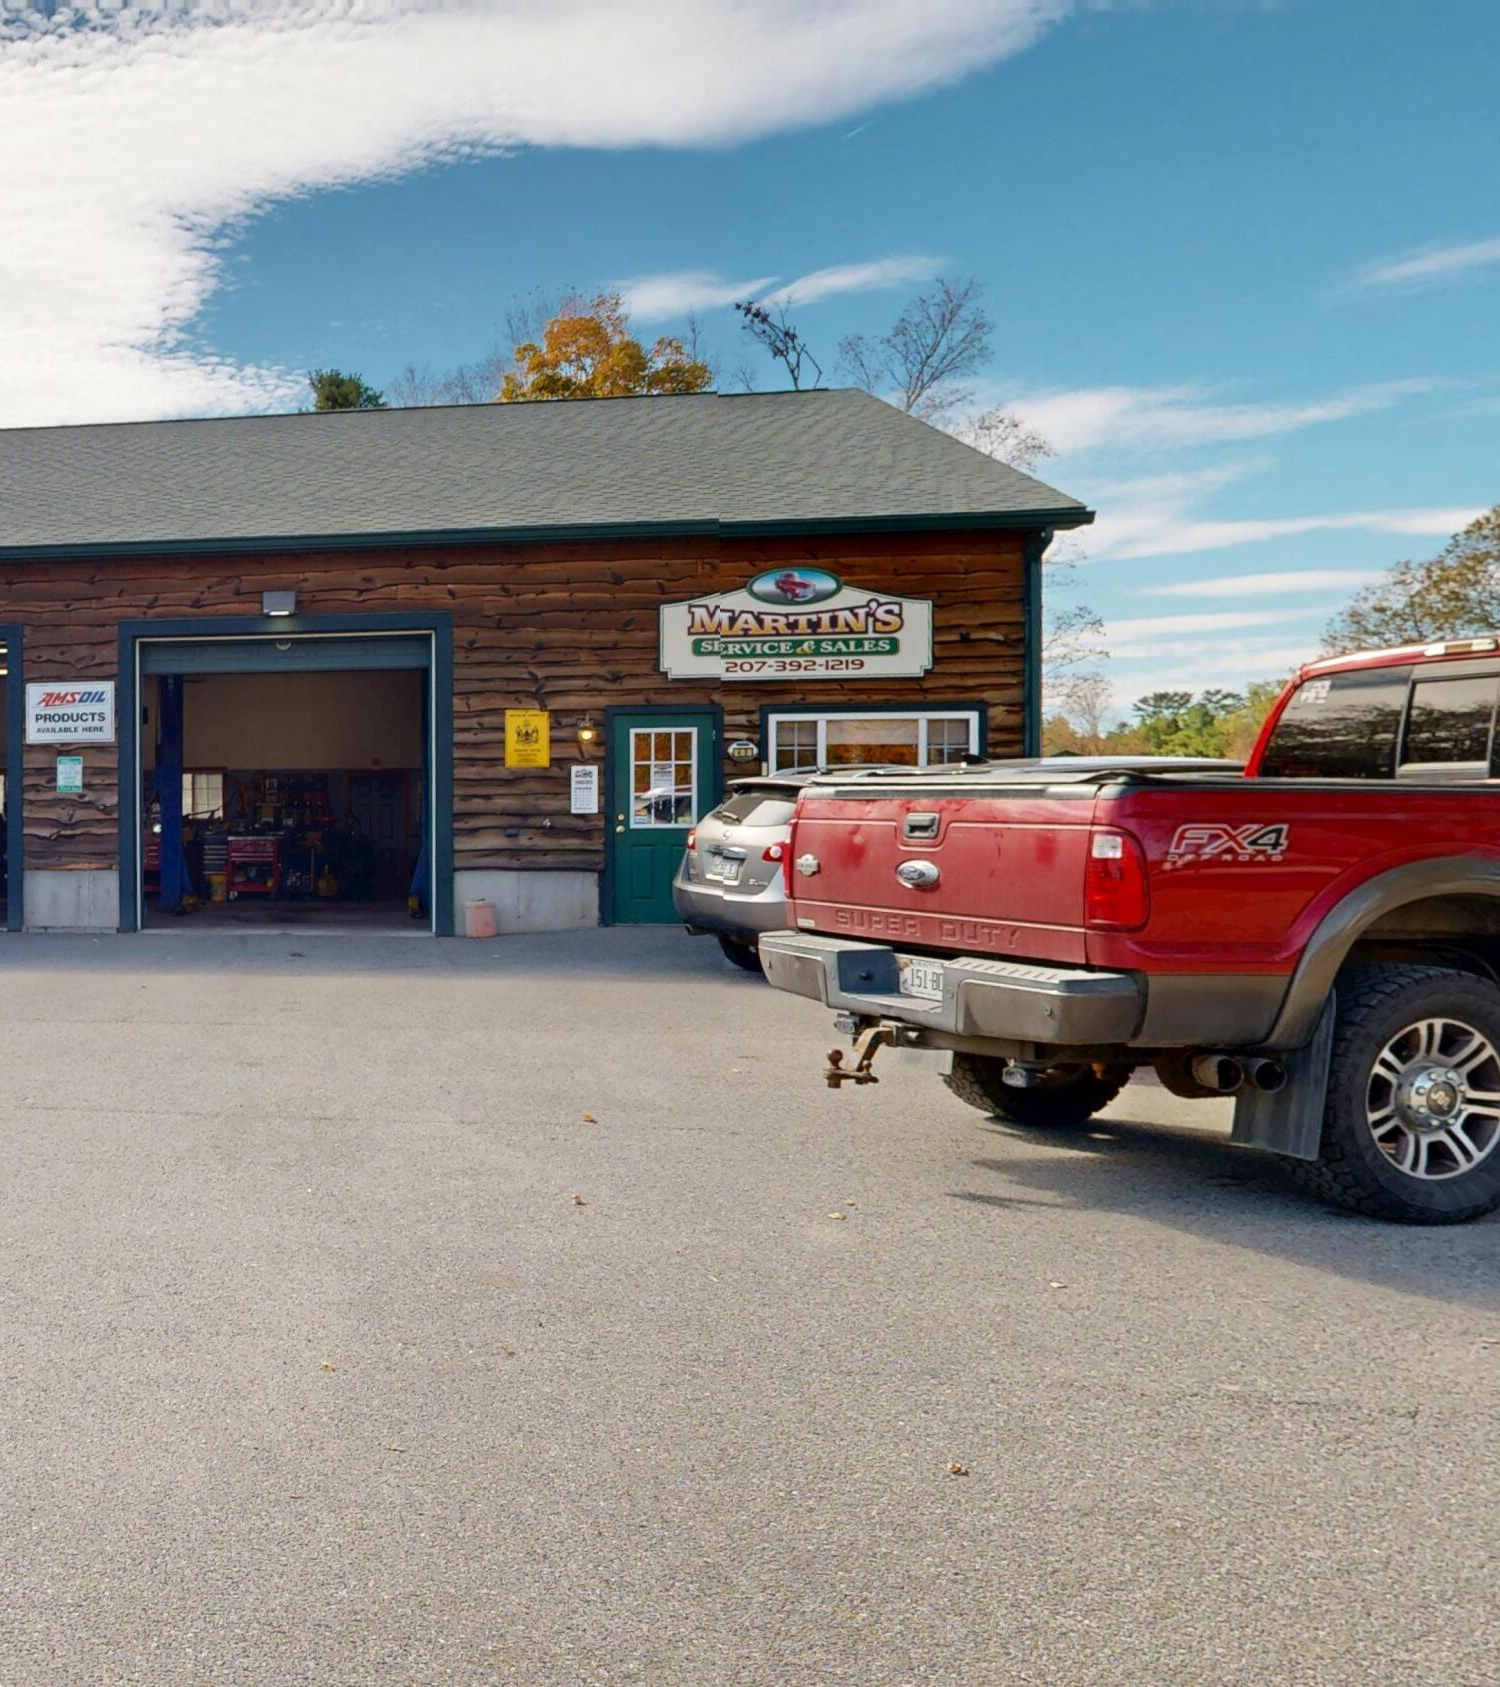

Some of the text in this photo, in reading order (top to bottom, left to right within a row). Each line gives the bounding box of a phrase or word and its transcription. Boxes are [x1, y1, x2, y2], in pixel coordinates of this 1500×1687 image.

[688, 598, 904, 637] MARTIN'S
[700, 640, 793, 655] SERVICE
[820, 639, 891, 652] SALES
[725, 659, 866, 673] 207-392-1219
[36, 691, 107, 707] AMSOIL
[35, 712, 106, 723] PRODUCTS
[36, 726, 79, 734] AVAILABLE
[1169, 824, 1289, 854] FX4
[835, 909, 1021, 948] SUPER DUTY
